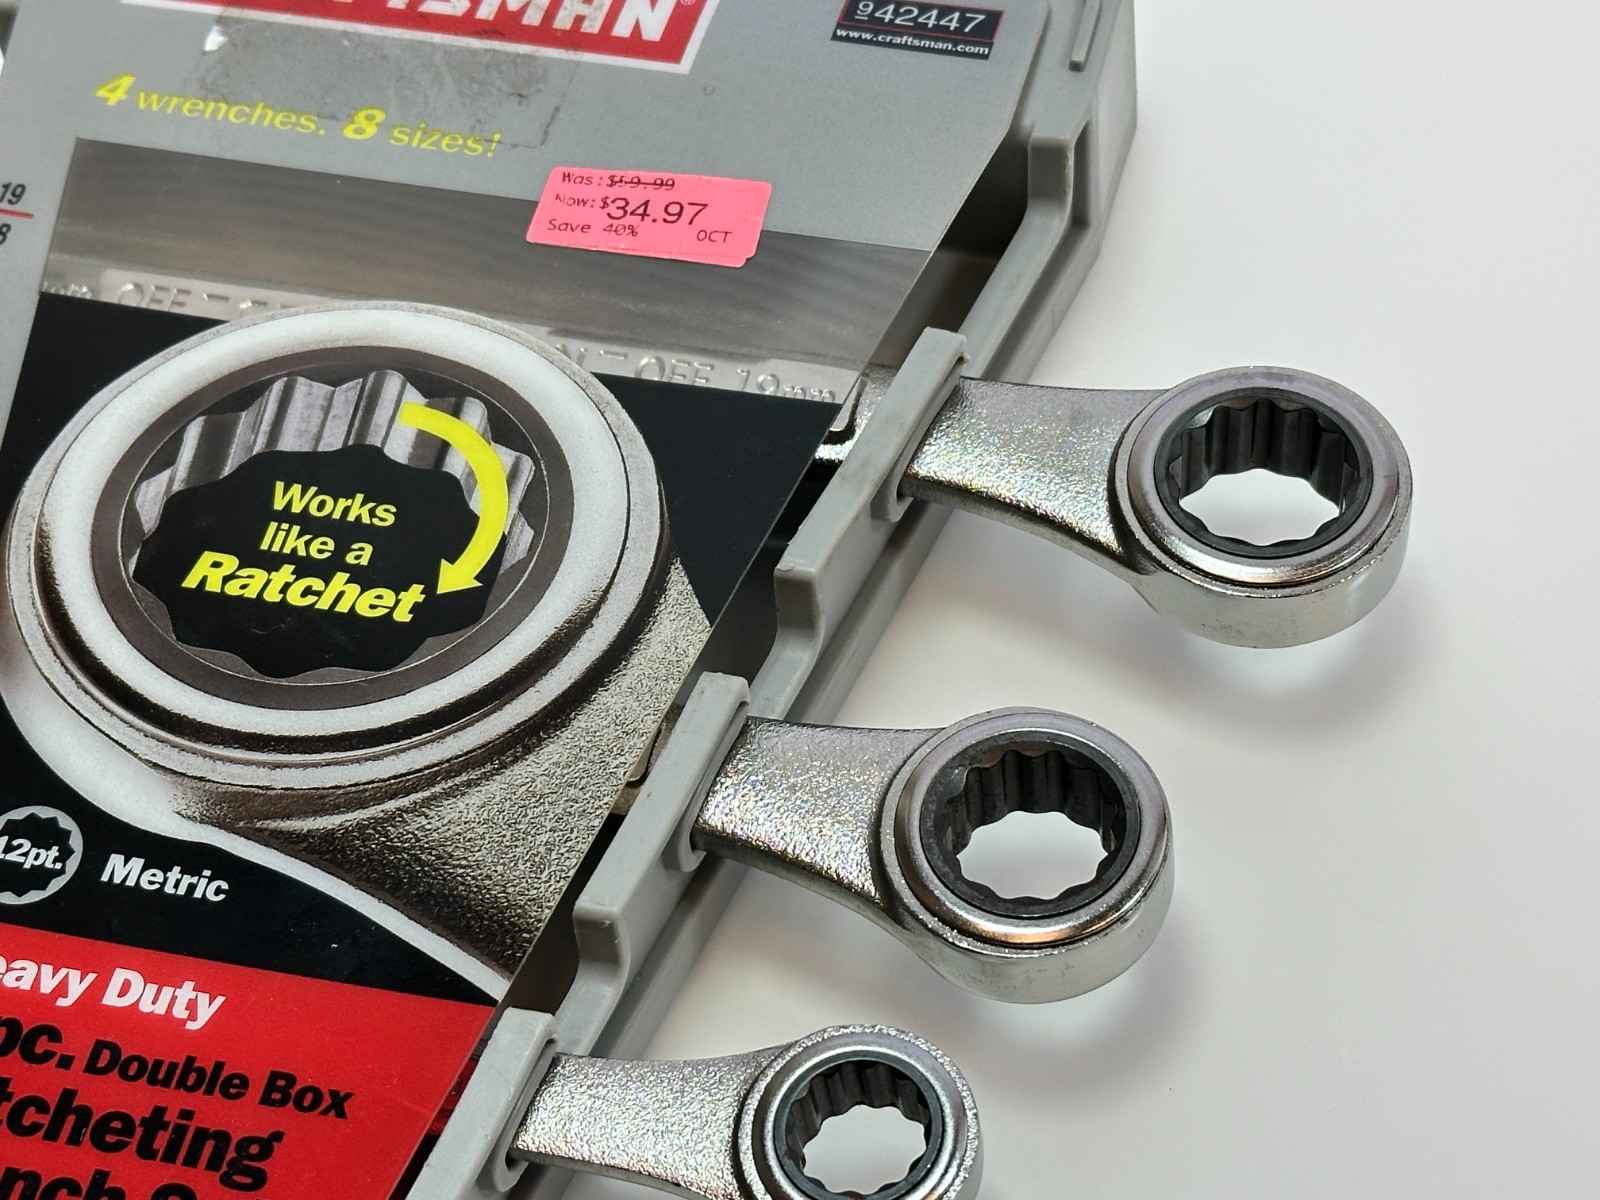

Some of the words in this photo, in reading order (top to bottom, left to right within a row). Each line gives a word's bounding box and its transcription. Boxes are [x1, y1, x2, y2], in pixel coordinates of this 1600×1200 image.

[854, 1, 986, 33] 942447
[836, 28, 989, 55] www.craftsman.com
[95, 74, 136, 106] 4
[137, 90, 326, 136] wrenches.
[343, 108, 386, 140] 8
[389, 122, 502, 158] sizes!
[547, 218, 592, 234] Save
[602, 223, 641, 238] 40%
[696, 230, 733, 244] OCT
[599, 196, 709, 226] $34.97
[273, 480, 397, 527] Works
[259, 521, 335, 560] like
[345, 541, 373, 566] a
[181, 550, 426, 623] Ratchet
[0, 835, 63, 869] 12pt.
[100, 853, 229, 902] Metric
[0, 954, 98, 1007] avy
[102, 967, 226, 1030] Duty
[83, 1038, 250, 1101] Double
[258, 1069, 355, 1119] Box
